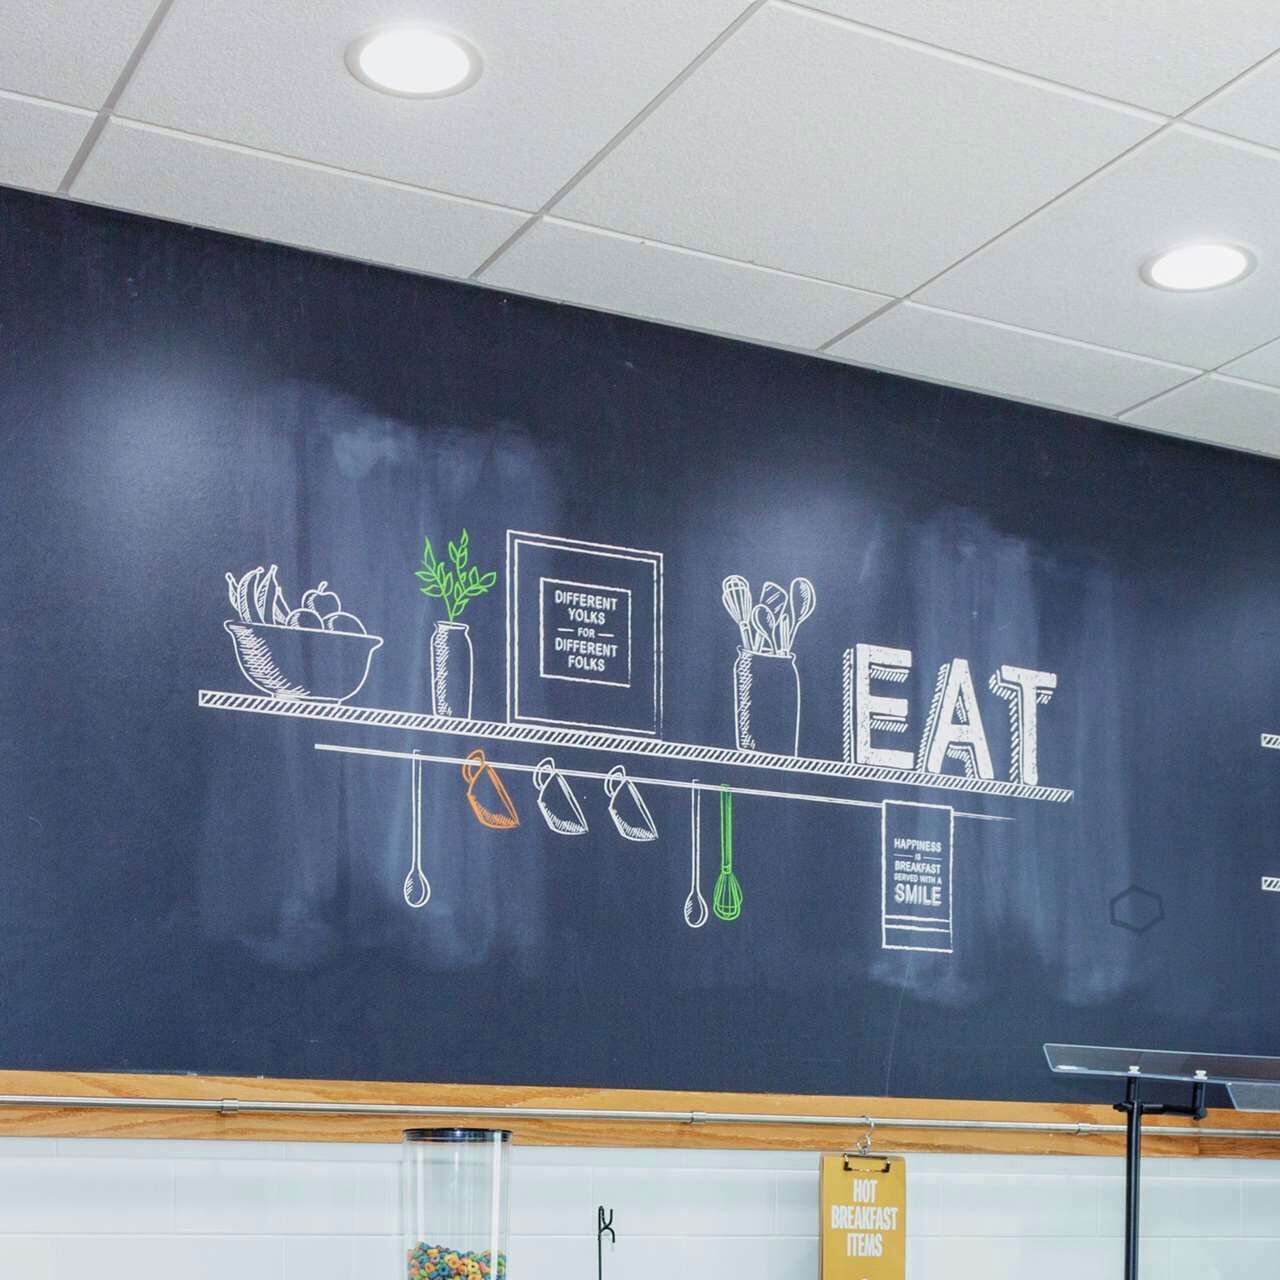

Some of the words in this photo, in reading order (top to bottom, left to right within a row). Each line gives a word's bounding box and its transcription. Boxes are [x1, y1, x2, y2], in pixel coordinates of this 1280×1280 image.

[555, 590, 618, 610] DIFFERENT
[568, 608, 606, 625] YOLKS
[578, 628, 596, 638] FOR
[555, 638, 618, 658] DIFFERENT
[568, 655, 606, 672] FOLKS
[843, 643, 1058, 786] EAT
[894, 838, 942, 852] HAPPINESS
[914, 853, 922, 861] IS
[894, 860, 941, 874] BREAKFAST
[894, 872, 918, 882] SERVED
[920, 875, 936, 884] WITH
[936, 877, 942, 885] A
[894, 883, 942, 907] SMILE
[853, 1178, 878, 1202] HOT
[831, 1205, 898, 1231] BREAKFAST
[847, 1232, 883, 1257] ITEMS
